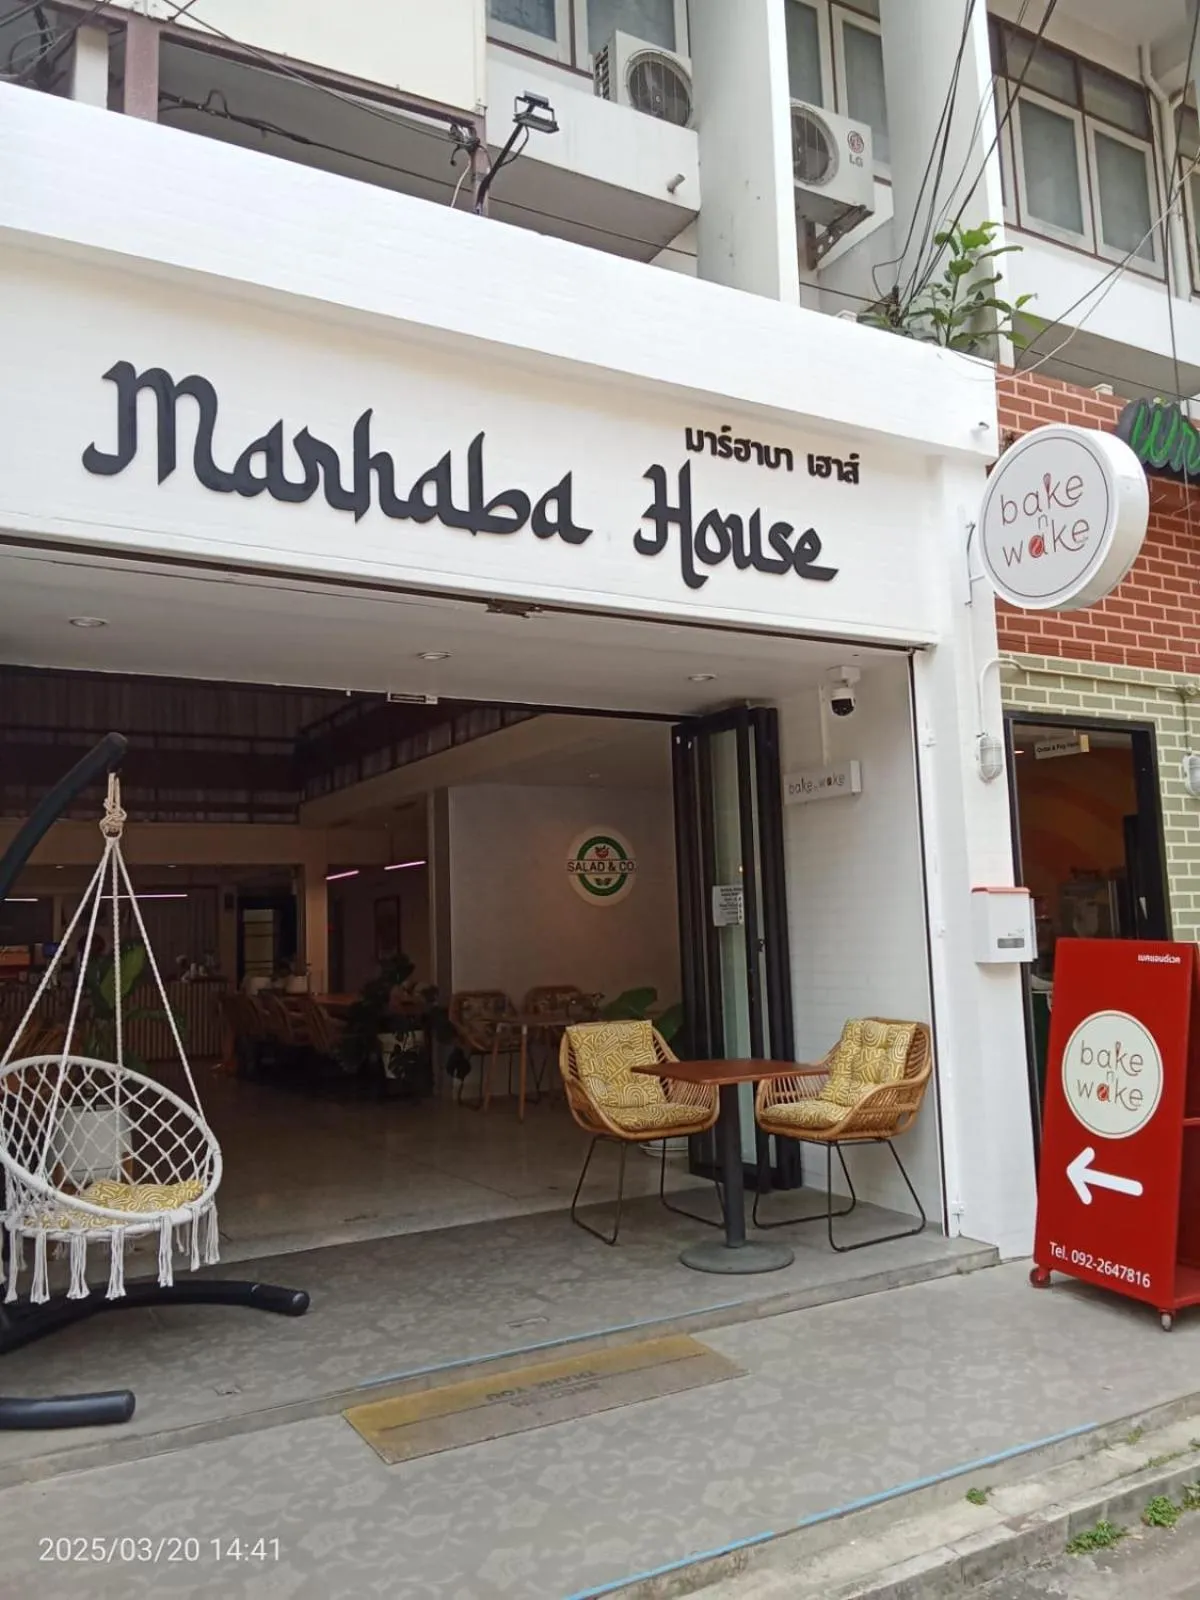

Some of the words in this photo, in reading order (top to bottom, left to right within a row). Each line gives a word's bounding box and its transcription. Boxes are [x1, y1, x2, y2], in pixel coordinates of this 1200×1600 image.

[849, 153, 863, 168] LG
[685, 425, 793, 472] มาร์ฮาบา
[807, 453, 859, 485] เฮาส์
[82, 360, 593, 544] Marhaba
[633, 459, 839, 589] House
[1000, 473, 1084, 525] bake
[1037, 514, 1049, 531] n
[1002, 519, 1090, 567] wake
[567, 861, 605, 873] SALAD
[608, 861, 617, 872] &
[1080, 1040, 1144, 1076] bake
[1106, 1070, 1115, 1082] n
[1076, 1078, 1144, 1111] wake
[1049, 1241, 1068, 1261] Tel.
[1071, 1249, 1151, 1288] 092-2647816
[486, 1386, 526, 1400] YOU
